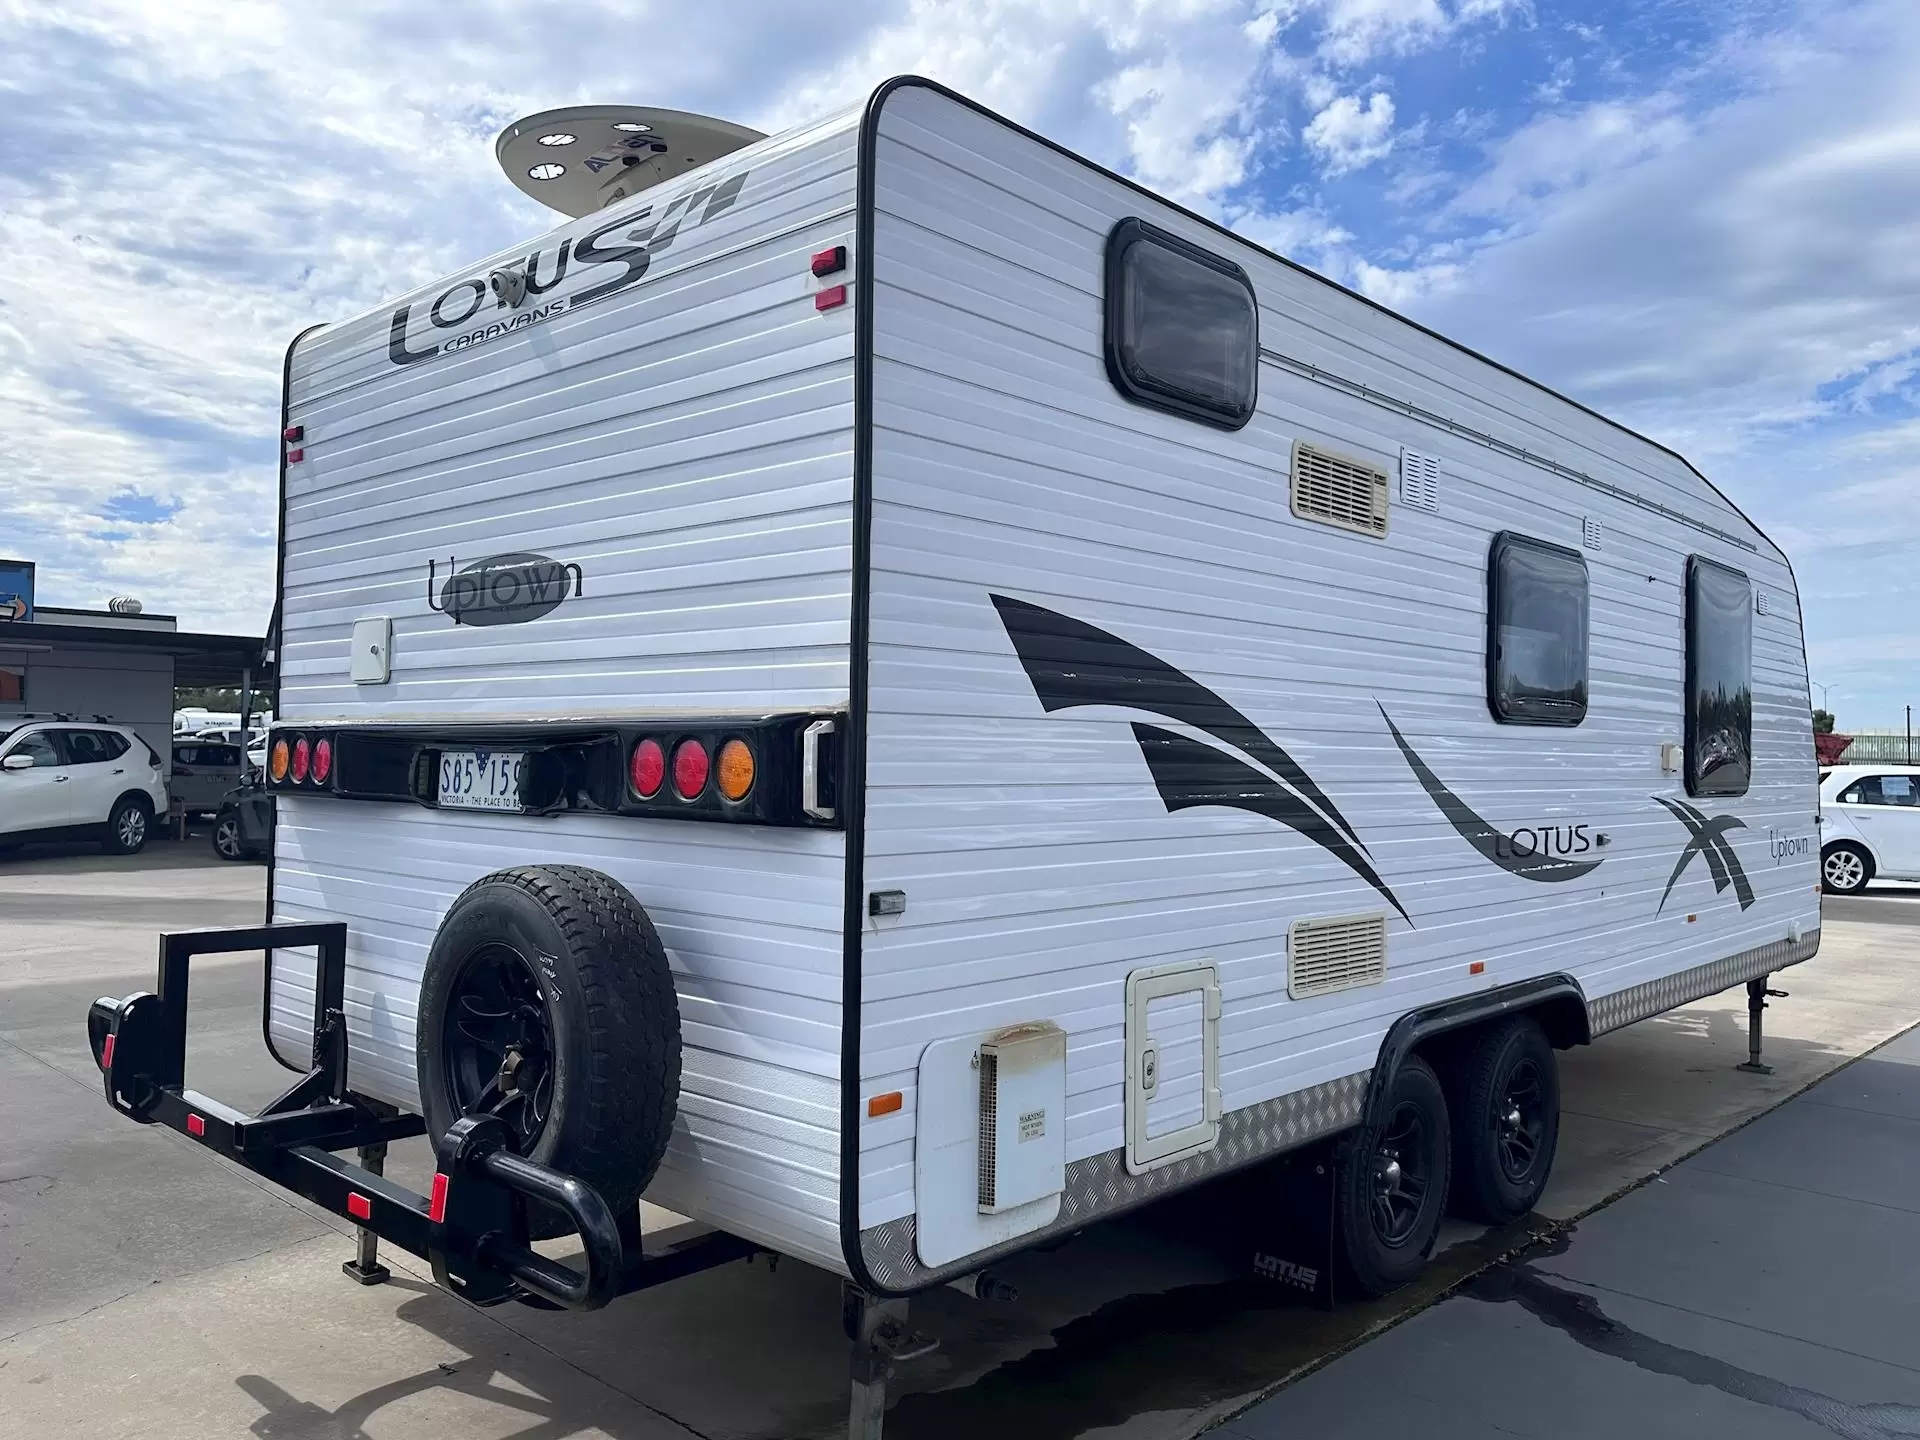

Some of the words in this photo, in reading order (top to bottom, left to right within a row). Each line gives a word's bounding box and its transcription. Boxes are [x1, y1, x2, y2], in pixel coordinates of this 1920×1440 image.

[444, 300, 565, 352] CARAVANS
[429, 556, 583, 625] Uptown
[441, 758, 474, 794] S85
[441, 795, 464, 804] VICTORIA
[471, 796, 482, 805] THE
[484, 797, 500, 807] PLACE
[503, 798, 510, 807] TO
[1494, 824, 1590, 860] LOTUS
[1769, 830, 1809, 865] Uptown
[1253, 1251, 1318, 1285] LOTUS
